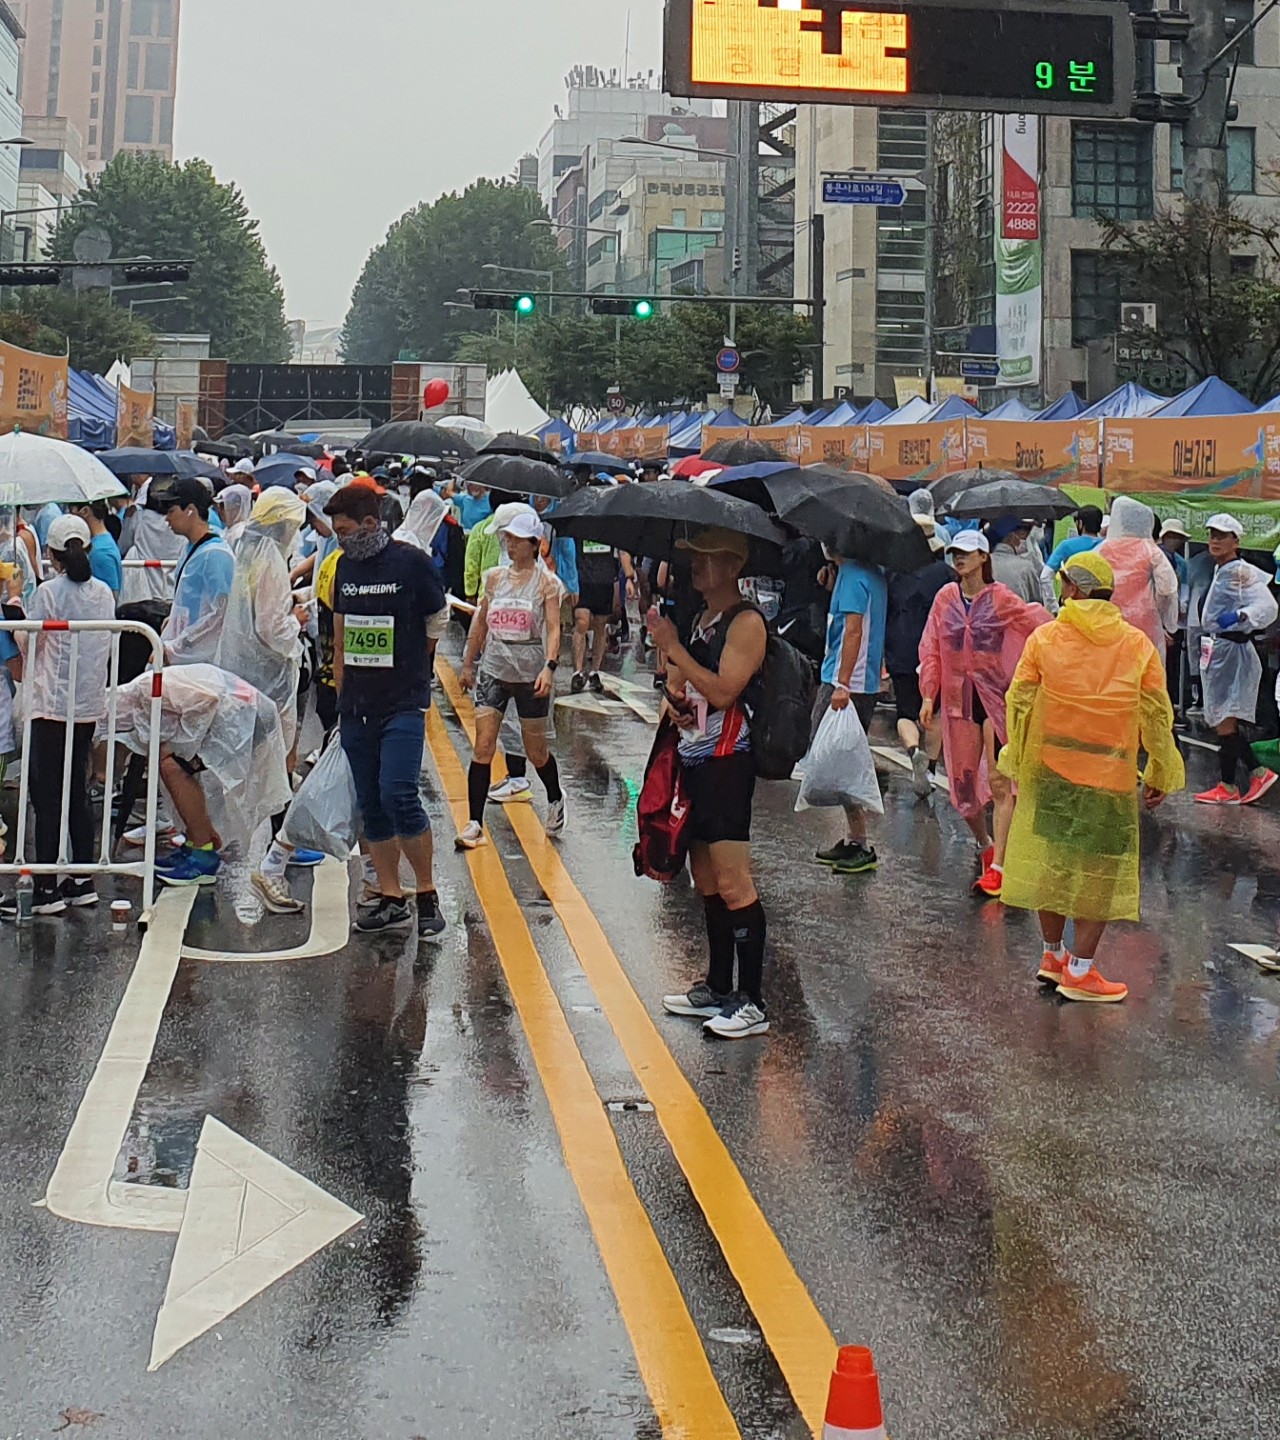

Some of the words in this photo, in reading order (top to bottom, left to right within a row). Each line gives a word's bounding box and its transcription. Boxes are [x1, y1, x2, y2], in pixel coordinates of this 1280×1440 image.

[1034, 61, 1054, 90] 9
[1066, 60, 1097, 93] 분
[1006, 202, 1036, 215] 2222
[1006, 219, 1037, 230] 4888
[610, 397, 622, 409] 50
[491, 611, 528, 626] 2043
[348, 630, 388, 648] 7496
